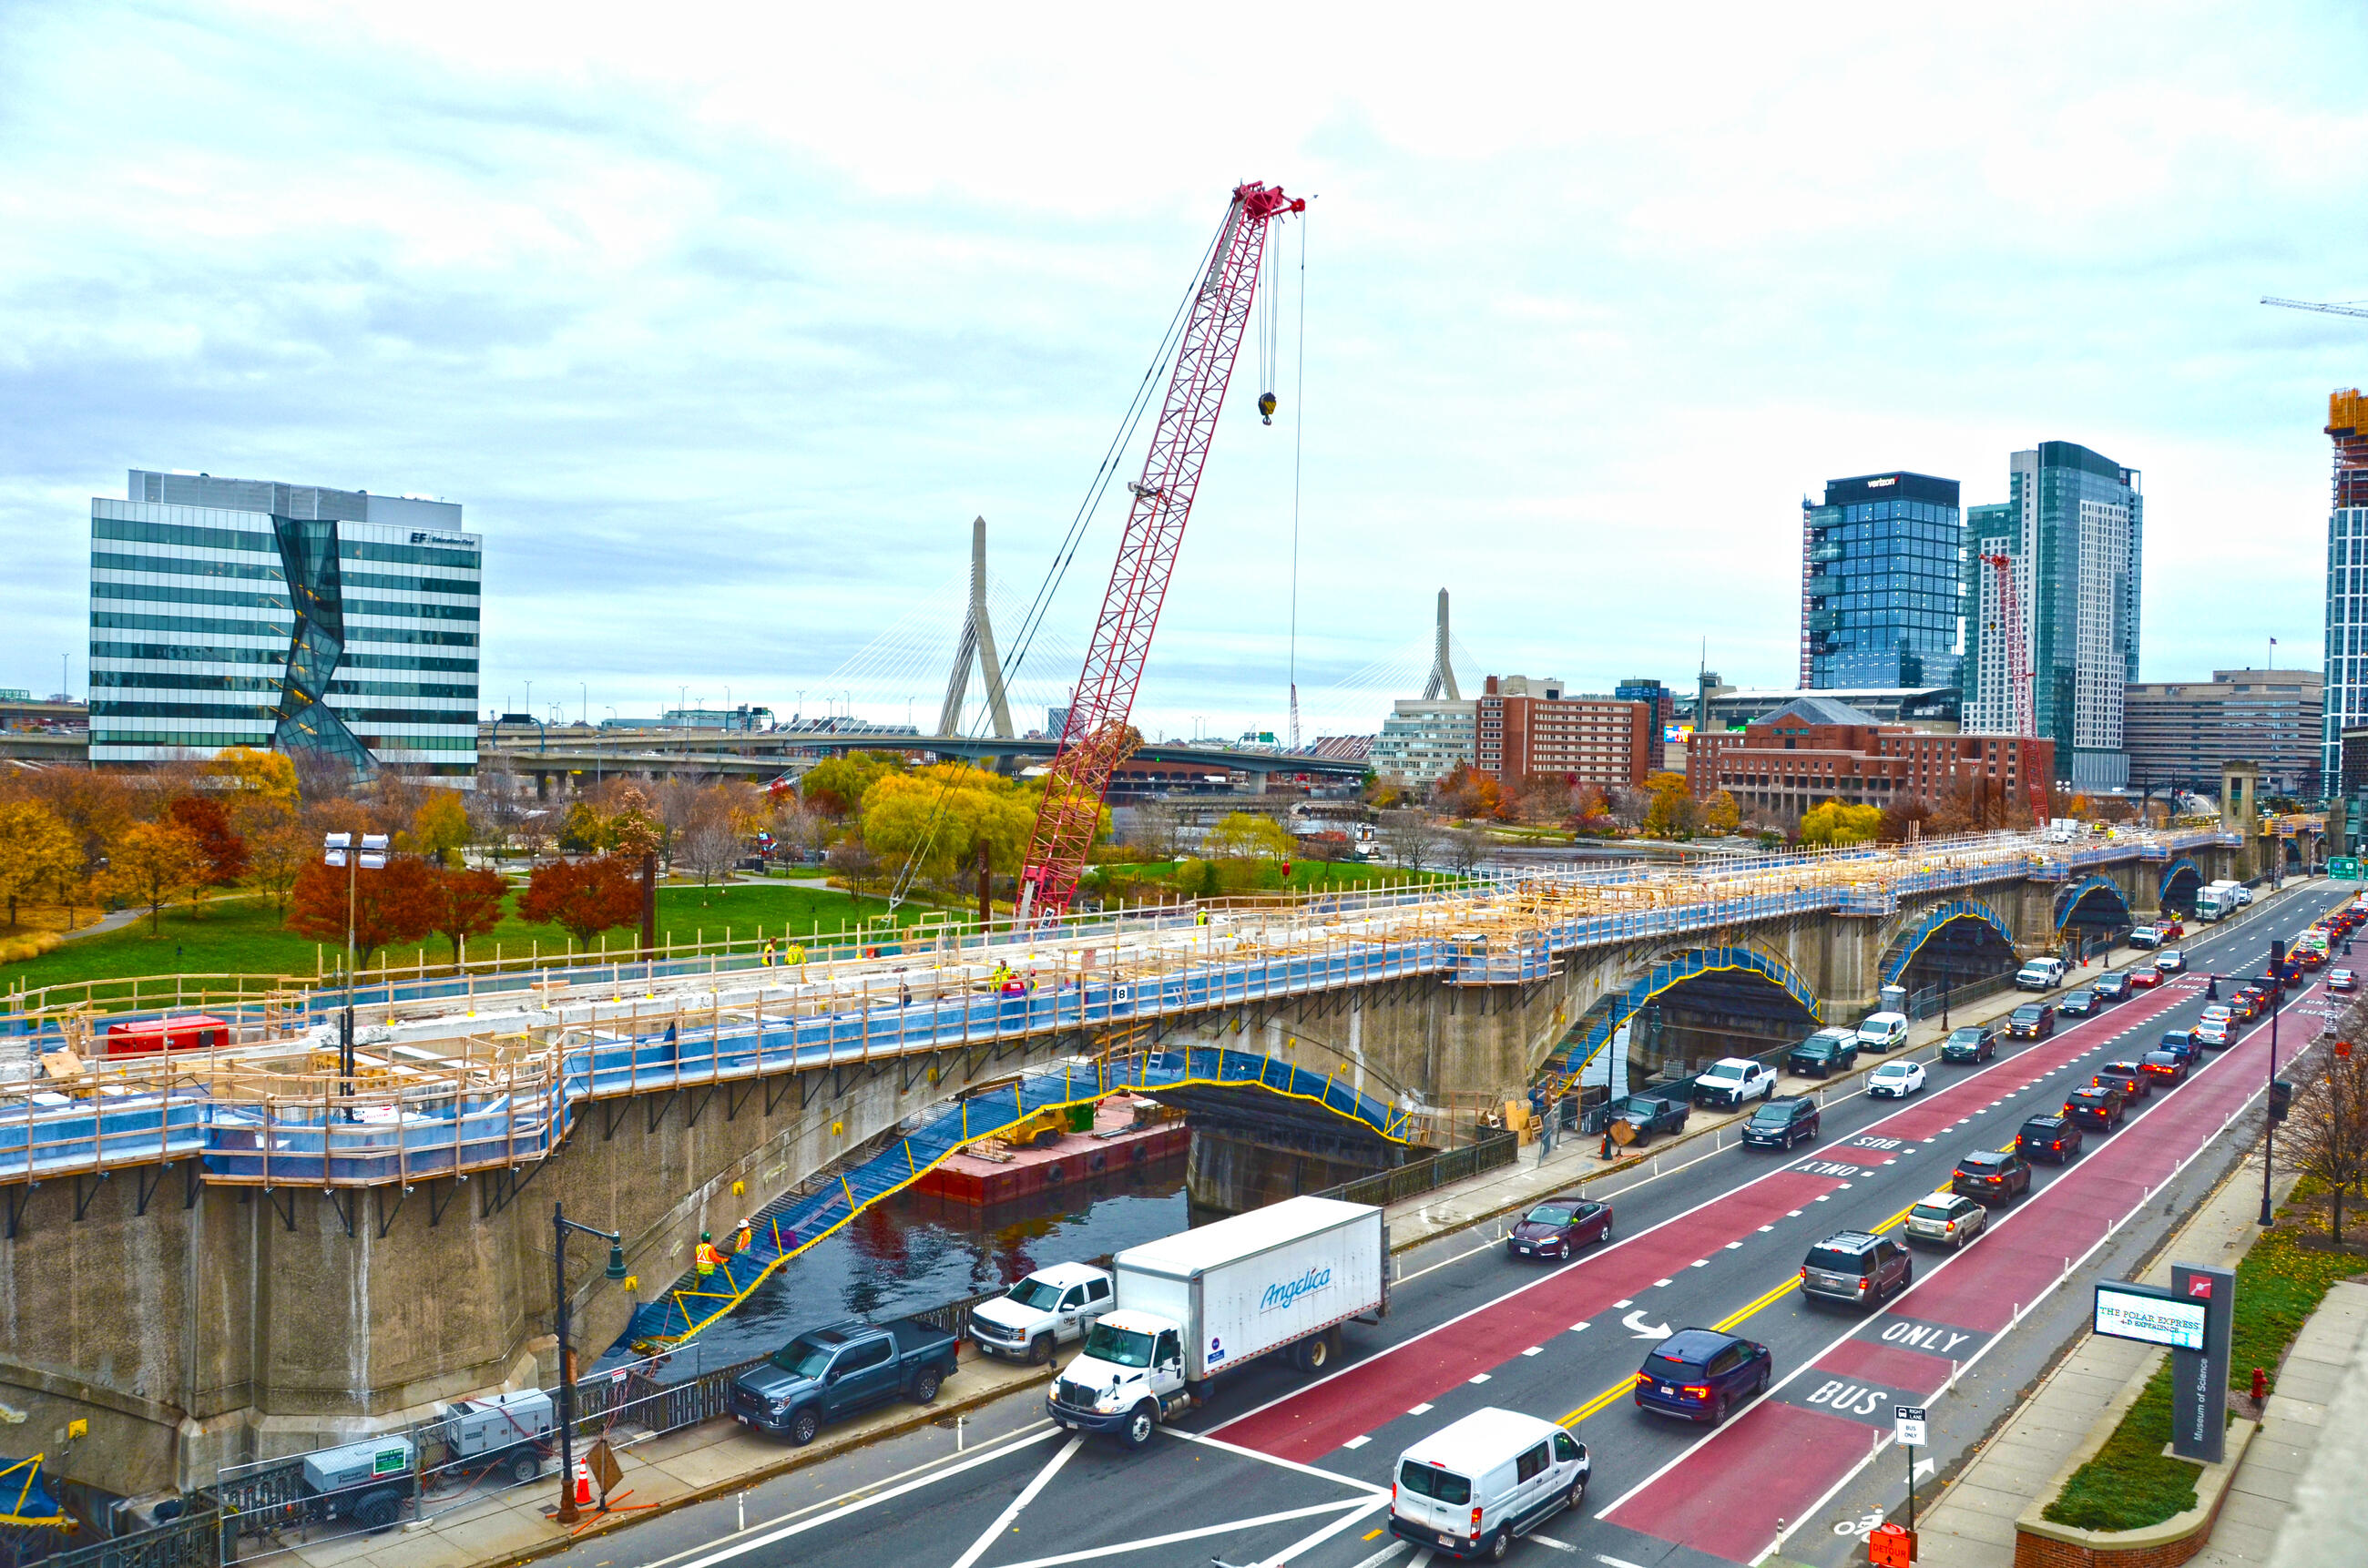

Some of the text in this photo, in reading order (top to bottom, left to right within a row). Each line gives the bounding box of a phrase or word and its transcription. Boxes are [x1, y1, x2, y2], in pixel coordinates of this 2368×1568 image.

[1868, 478, 1894, 488] verizon
[411, 532, 427, 543] EF
[1118, 989, 1126, 999] 8
[1853, 1136, 1903, 1150] BUS
[1795, 1161, 1859, 1176] ONLY
[1260, 1268, 1331, 1308] Angelica
[2099, 1306, 2200, 1330] THE POLAR EXPRESS
[2134, 1320, 2179, 1334] EXPERIENCE
[1881, 1322, 1971, 1353] ONLY
[1806, 1380, 1888, 1415] BUS
[2193, 1358, 2209, 1441] Museum of Science
[1873, 1543, 1906, 1558] DETOUR
